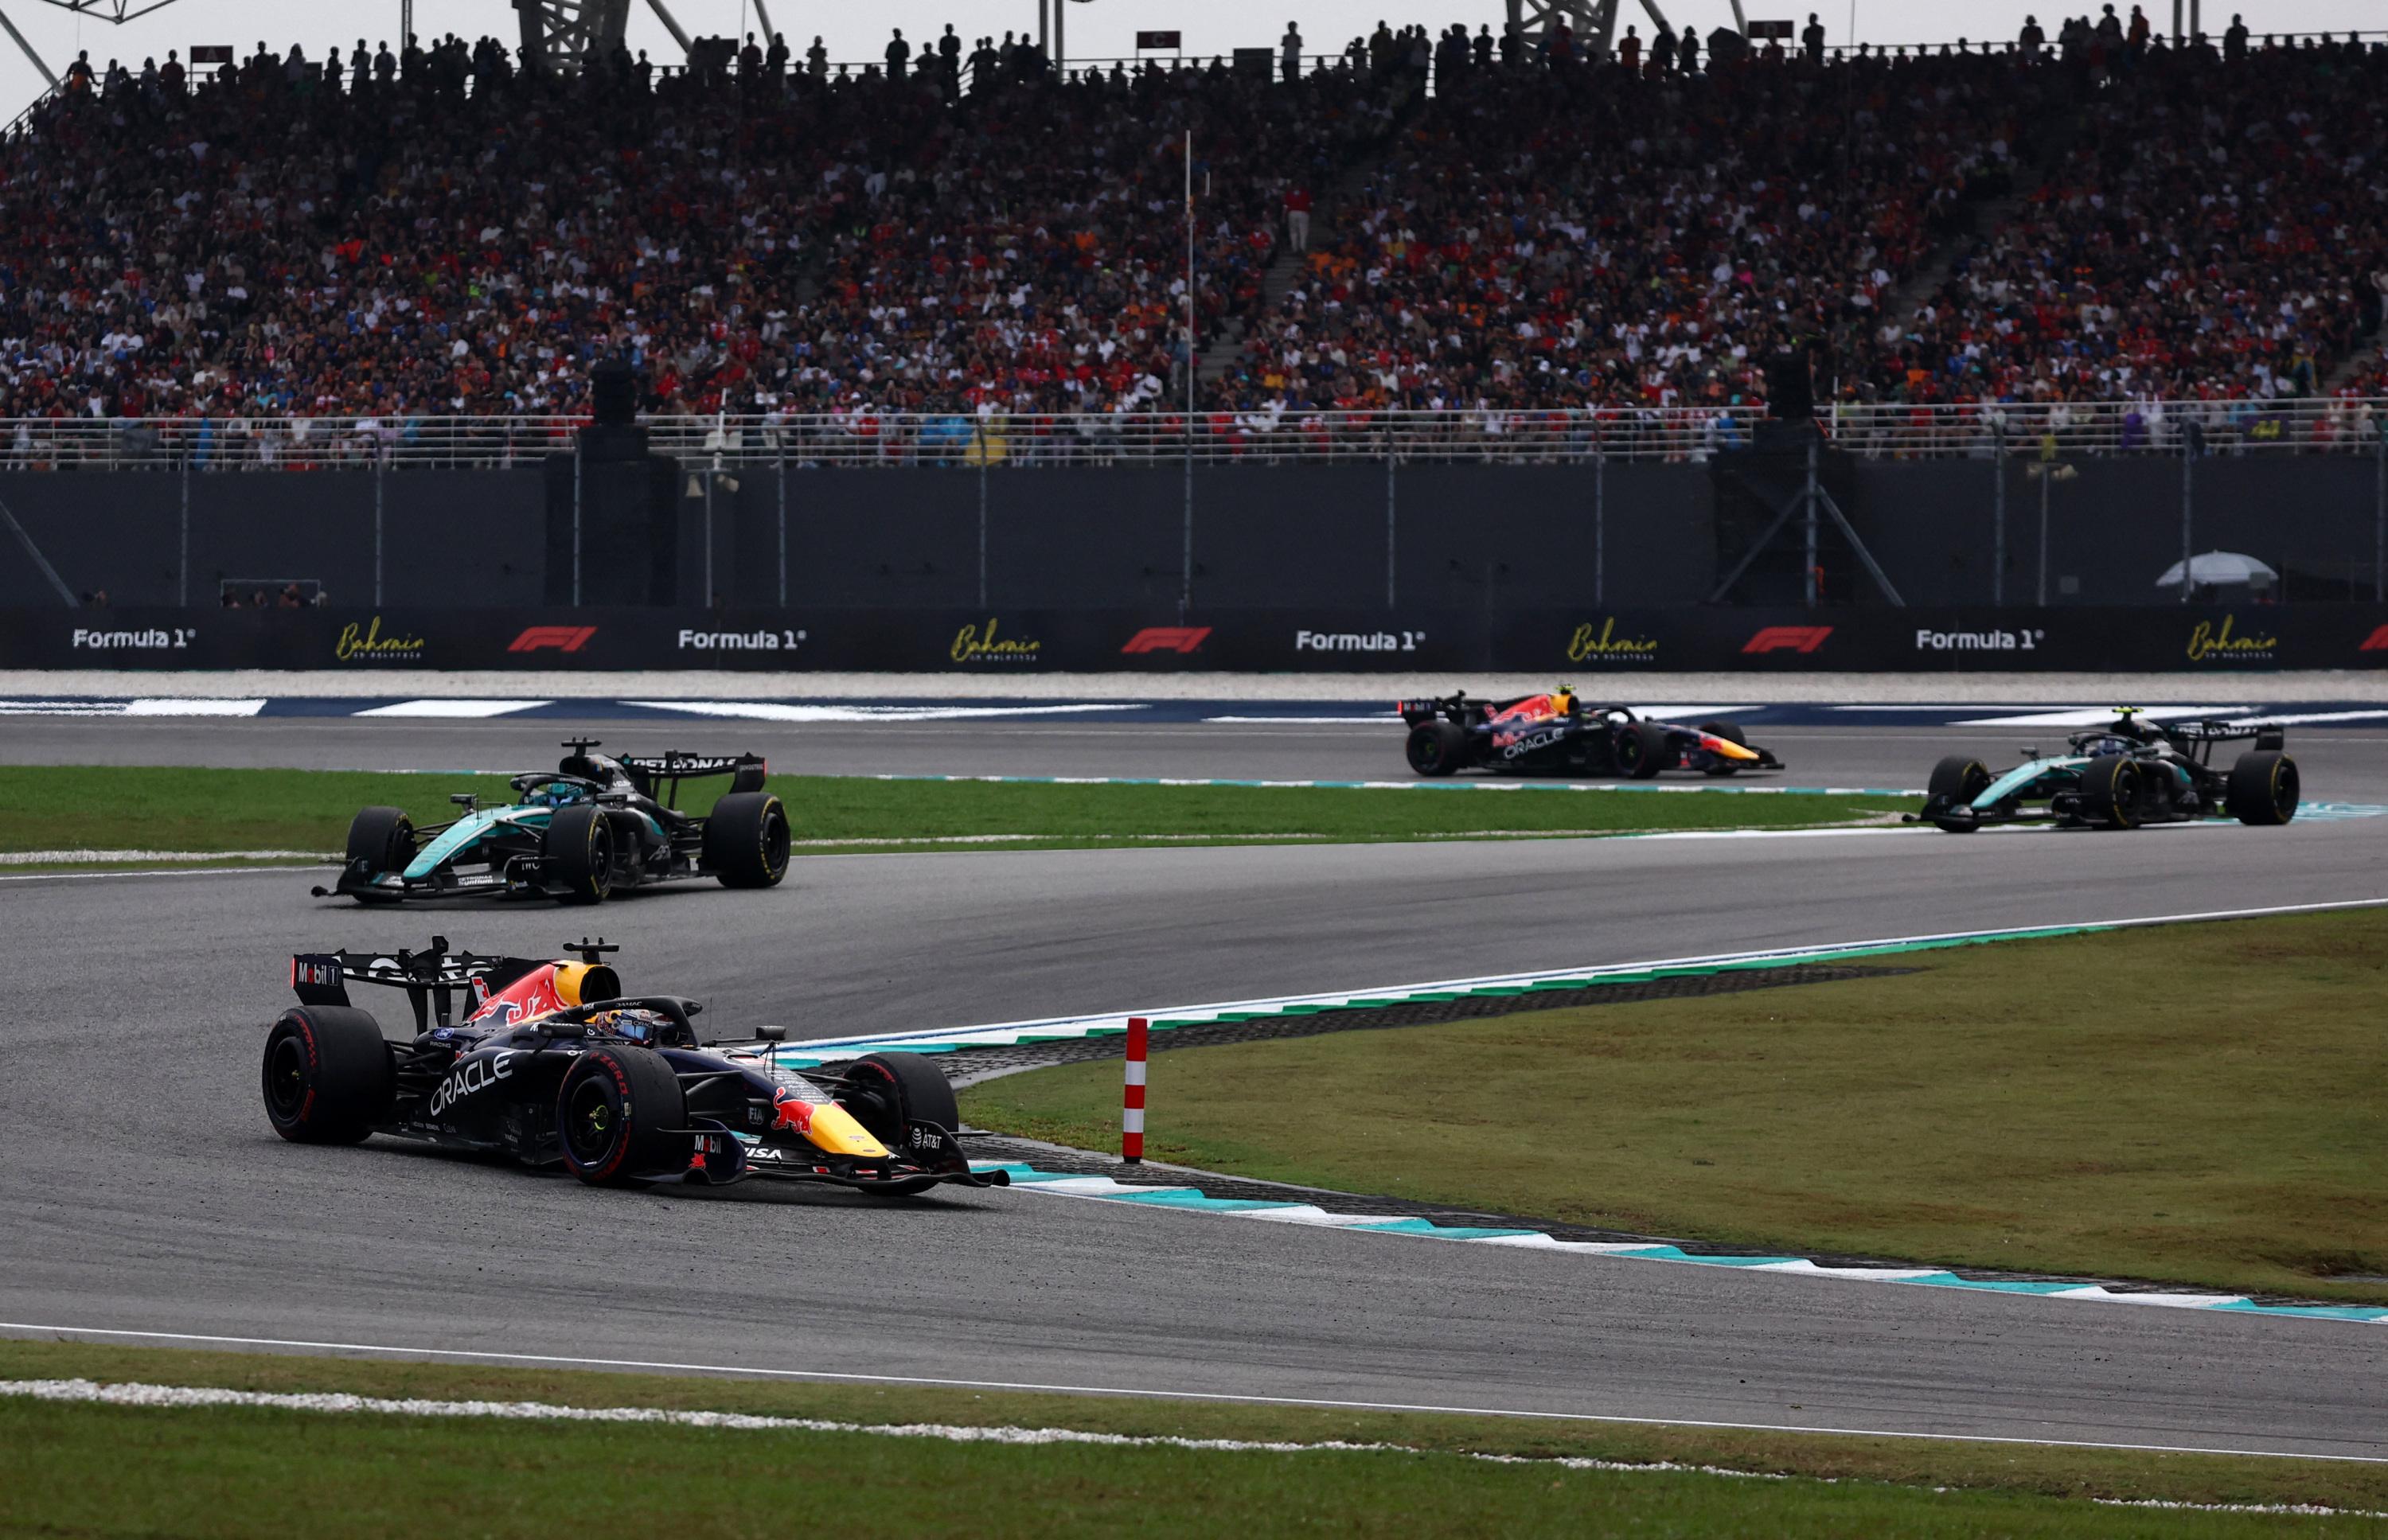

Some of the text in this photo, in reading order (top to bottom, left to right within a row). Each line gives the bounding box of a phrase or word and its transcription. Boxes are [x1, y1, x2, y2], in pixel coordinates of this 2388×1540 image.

[1152, 33, 1165, 47] C
[205, 48, 218, 61] A
[72, 629, 169, 648] Formula
[678, 630, 778, 649] Formula
[1297, 630, 1397, 650] Formula
[1917, 630, 2015, 649] Formula
[1503, 727, 1565, 759] ORACLE
[298, 961, 338, 985] Mobil 1
[429, 1040, 451, 1049] RACING
[589, 1052, 629, 1095] P ZERO
[430, 1051, 517, 1117] ORACLE
[748, 1107, 763, 1121] FIA
[694, 1134, 721, 1154] Mobil
[922, 1133, 942, 1149] AT&T
